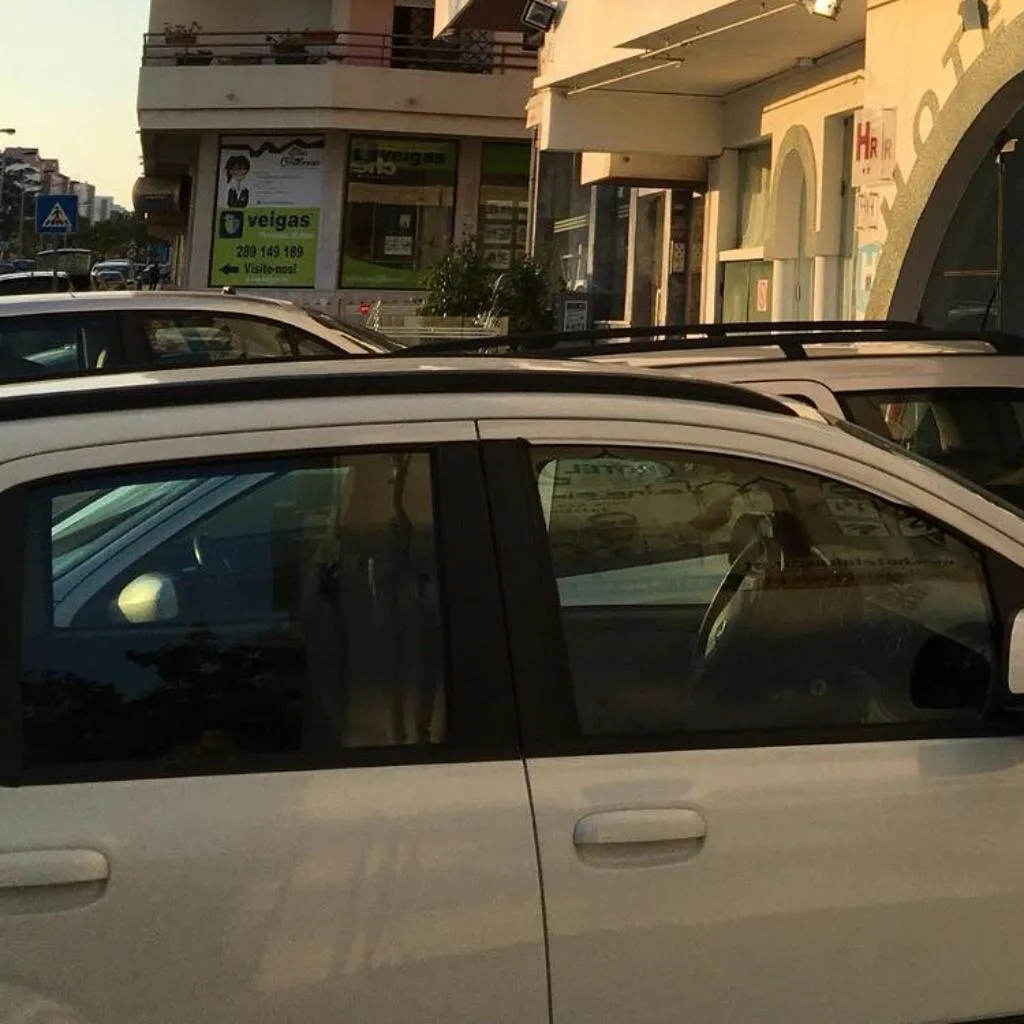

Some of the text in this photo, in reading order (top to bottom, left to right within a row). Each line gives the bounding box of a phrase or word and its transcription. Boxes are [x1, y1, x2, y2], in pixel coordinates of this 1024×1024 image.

[381, 149, 447, 166] veigas
[248, 210, 311, 232] veigas
[261, 245, 280, 259] 149
